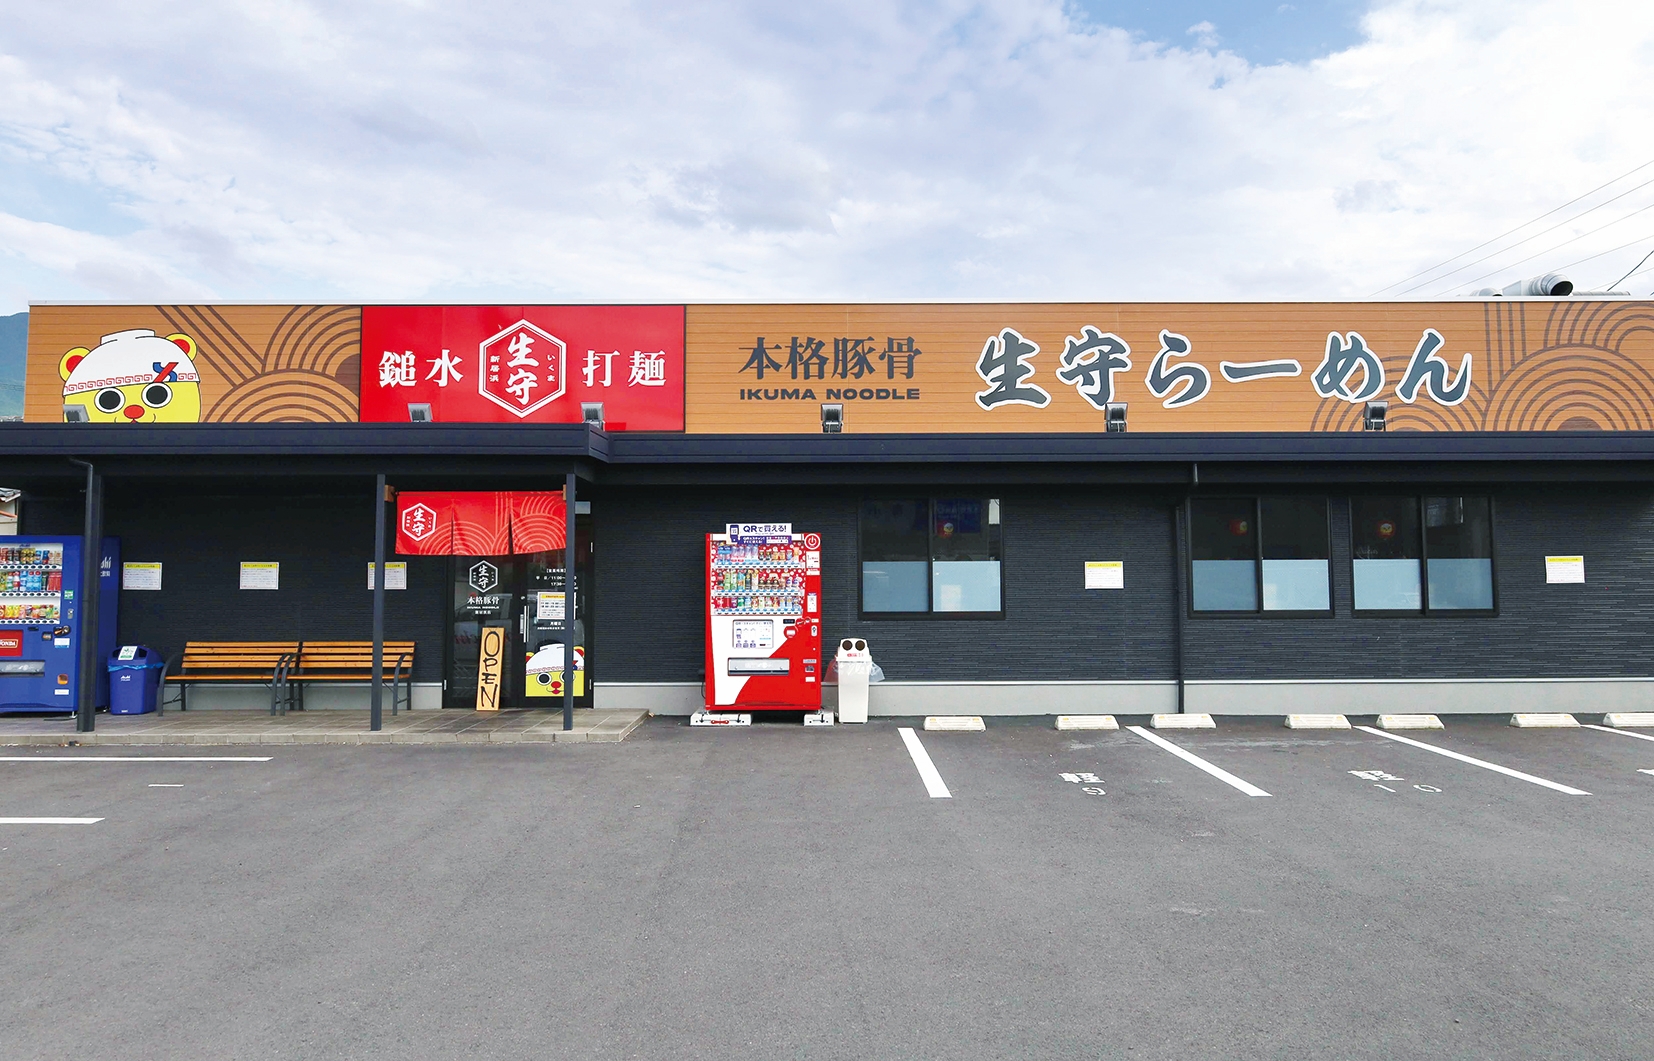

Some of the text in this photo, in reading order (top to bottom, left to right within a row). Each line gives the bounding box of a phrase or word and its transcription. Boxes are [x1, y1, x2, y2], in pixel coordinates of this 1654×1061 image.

[505, 332, 540, 405] 生守
[738, 336, 922, 380] 本格豚骨
[740, 388, 920, 400] IKUMA NOODLE
[975, 327, 1472, 410] 生守らーめん
[480, 630, 501, 708] OPEN
